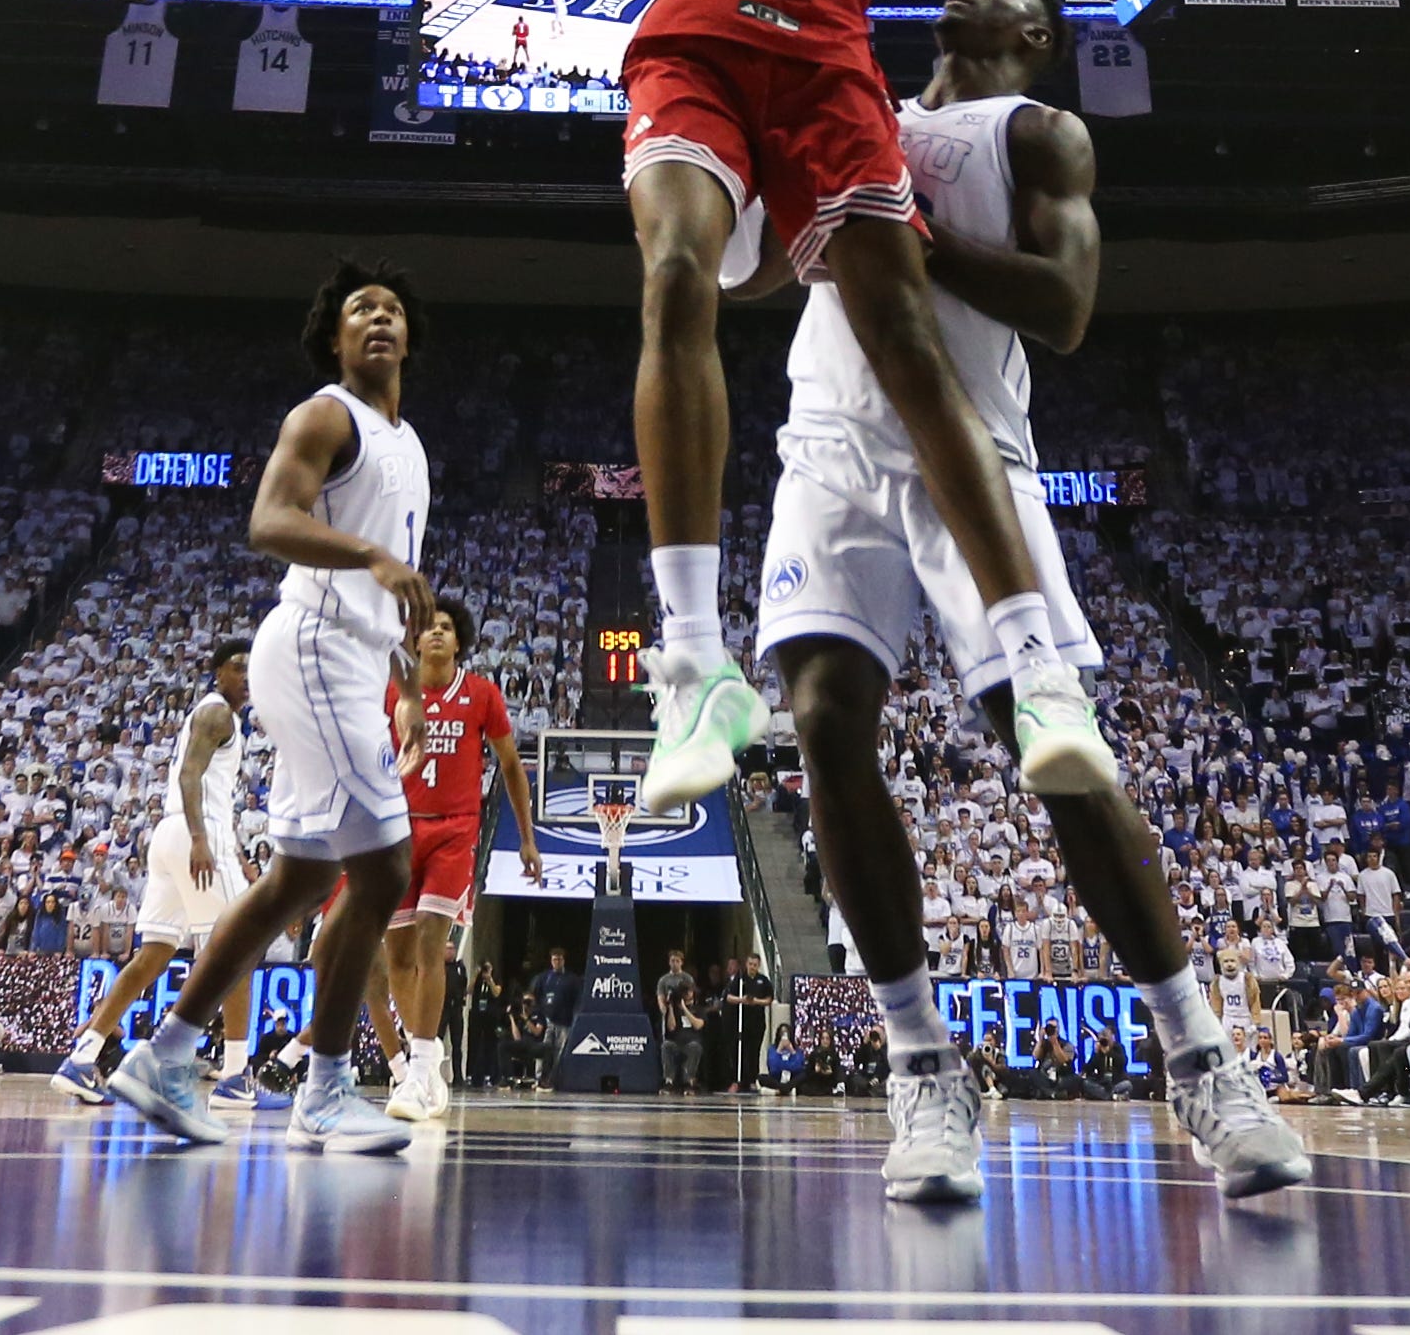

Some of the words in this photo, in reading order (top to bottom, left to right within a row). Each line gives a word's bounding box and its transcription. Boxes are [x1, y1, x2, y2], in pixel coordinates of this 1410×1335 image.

[127, 40, 152, 66] 11
[259, 47, 289, 73] 14
[1092, 44, 1132, 67] 22
[544, 92, 556, 108] 8
[135, 452, 234, 488] DEFENSE
[405, 511, 416, 565] 1
[598, 630, 641, 652] 13:59
[607, 652, 637, 683] 11
[421, 758, 438, 789] 4
[1053, 946, 1067, 958] 23
[606, 1035, 647, 1044] MOUNTAIN
[608, 1043, 644, 1052] AMERICA
